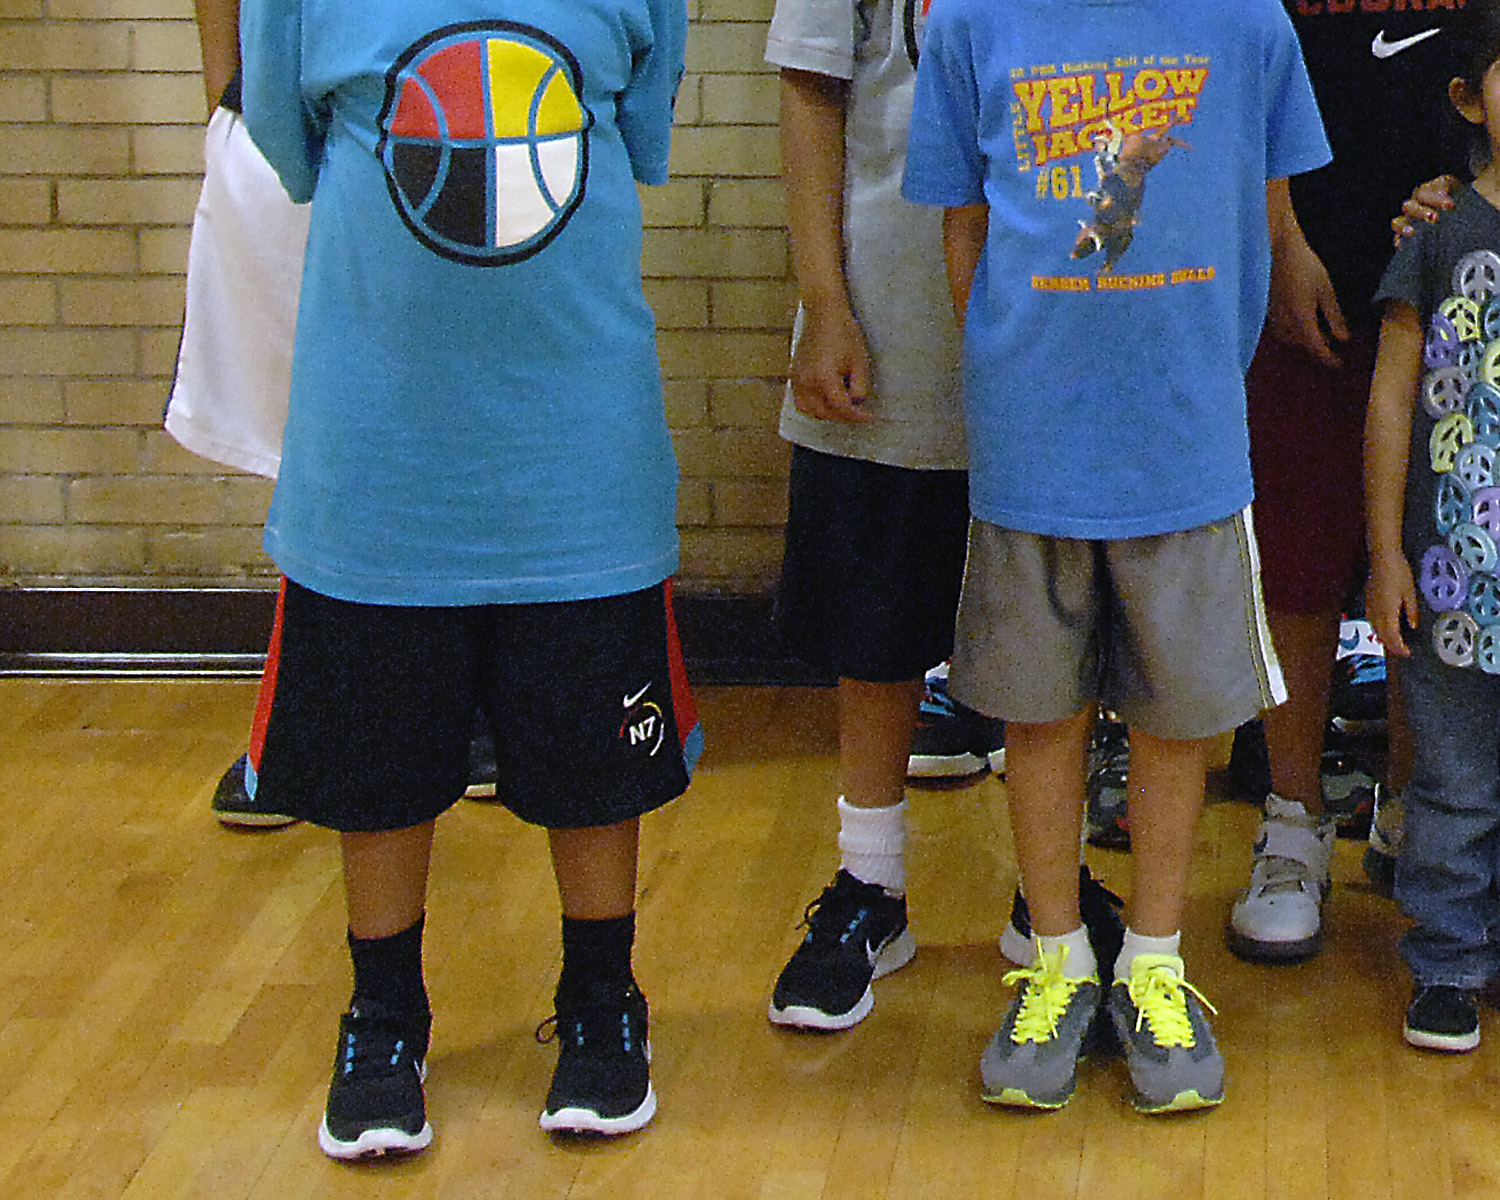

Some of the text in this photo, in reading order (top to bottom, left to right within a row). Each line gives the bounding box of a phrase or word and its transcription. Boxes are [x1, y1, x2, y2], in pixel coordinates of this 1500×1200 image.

[1014, 68, 1209, 132] YELLOW
[1032, 96, 1197, 166] JACKET
[1036, 165, 1083, 200] #61
[629, 715, 656, 746] N7
